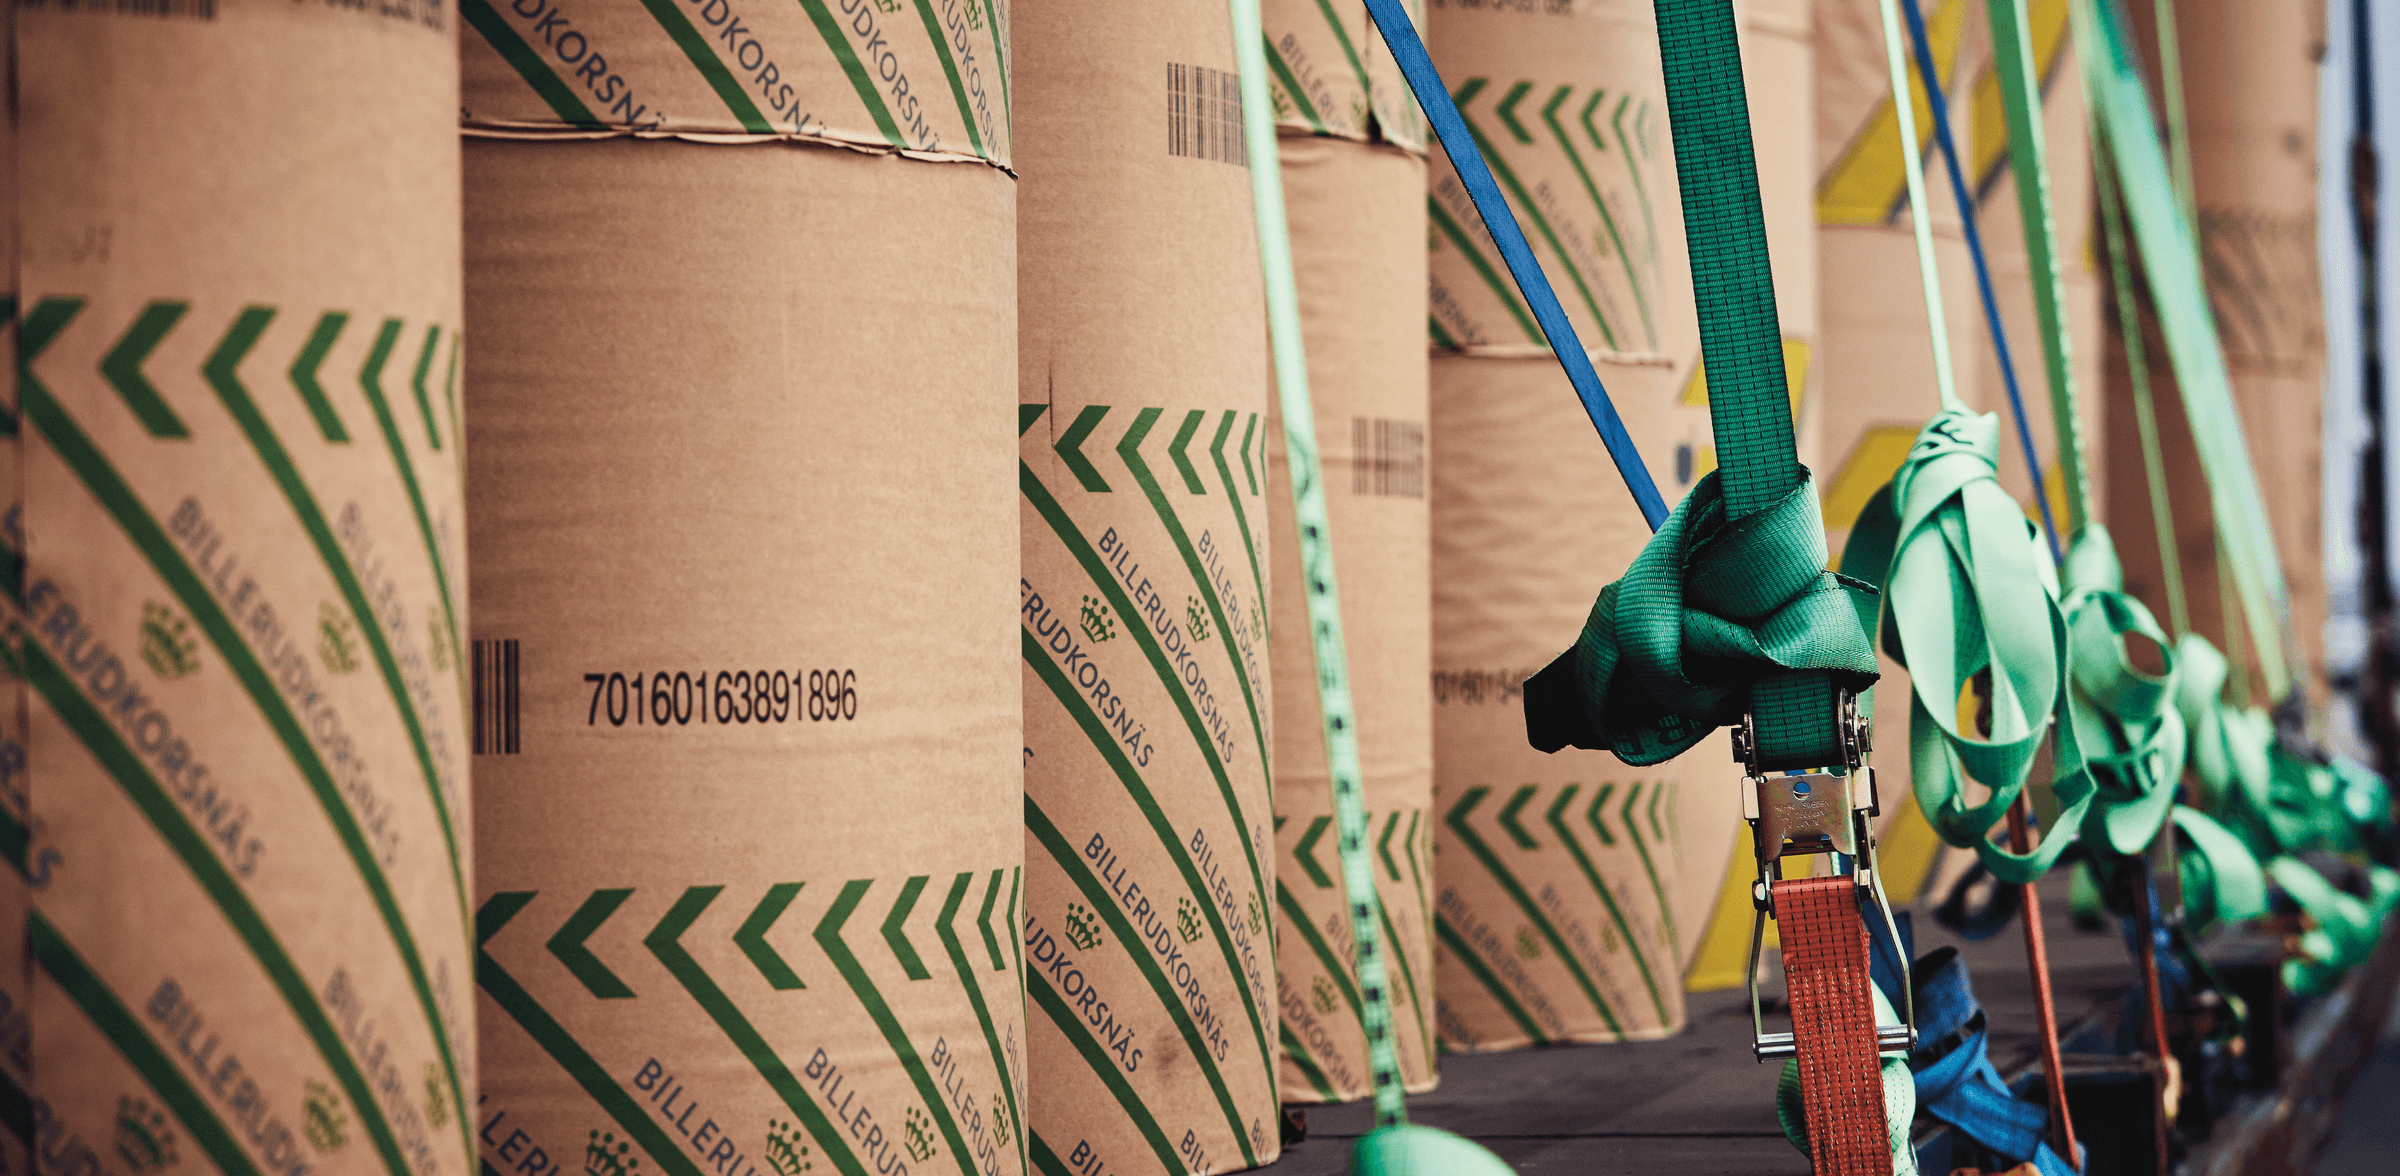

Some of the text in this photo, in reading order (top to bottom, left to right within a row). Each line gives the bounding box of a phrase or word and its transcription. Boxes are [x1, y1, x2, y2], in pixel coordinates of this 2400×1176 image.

[583, 668, 857, 727] 70160163891896
[1097, 526, 1234, 764] BILLERUDKORSNÄS
[1024, 907, 1143, 1073] UDKORSNÄS
[1084, 832, 1229, 1062] BILLERUDKORSNÄS
[477, 1094, 560, 1176] LER
[931, 1036, 1002, 1176] BILLERUD
